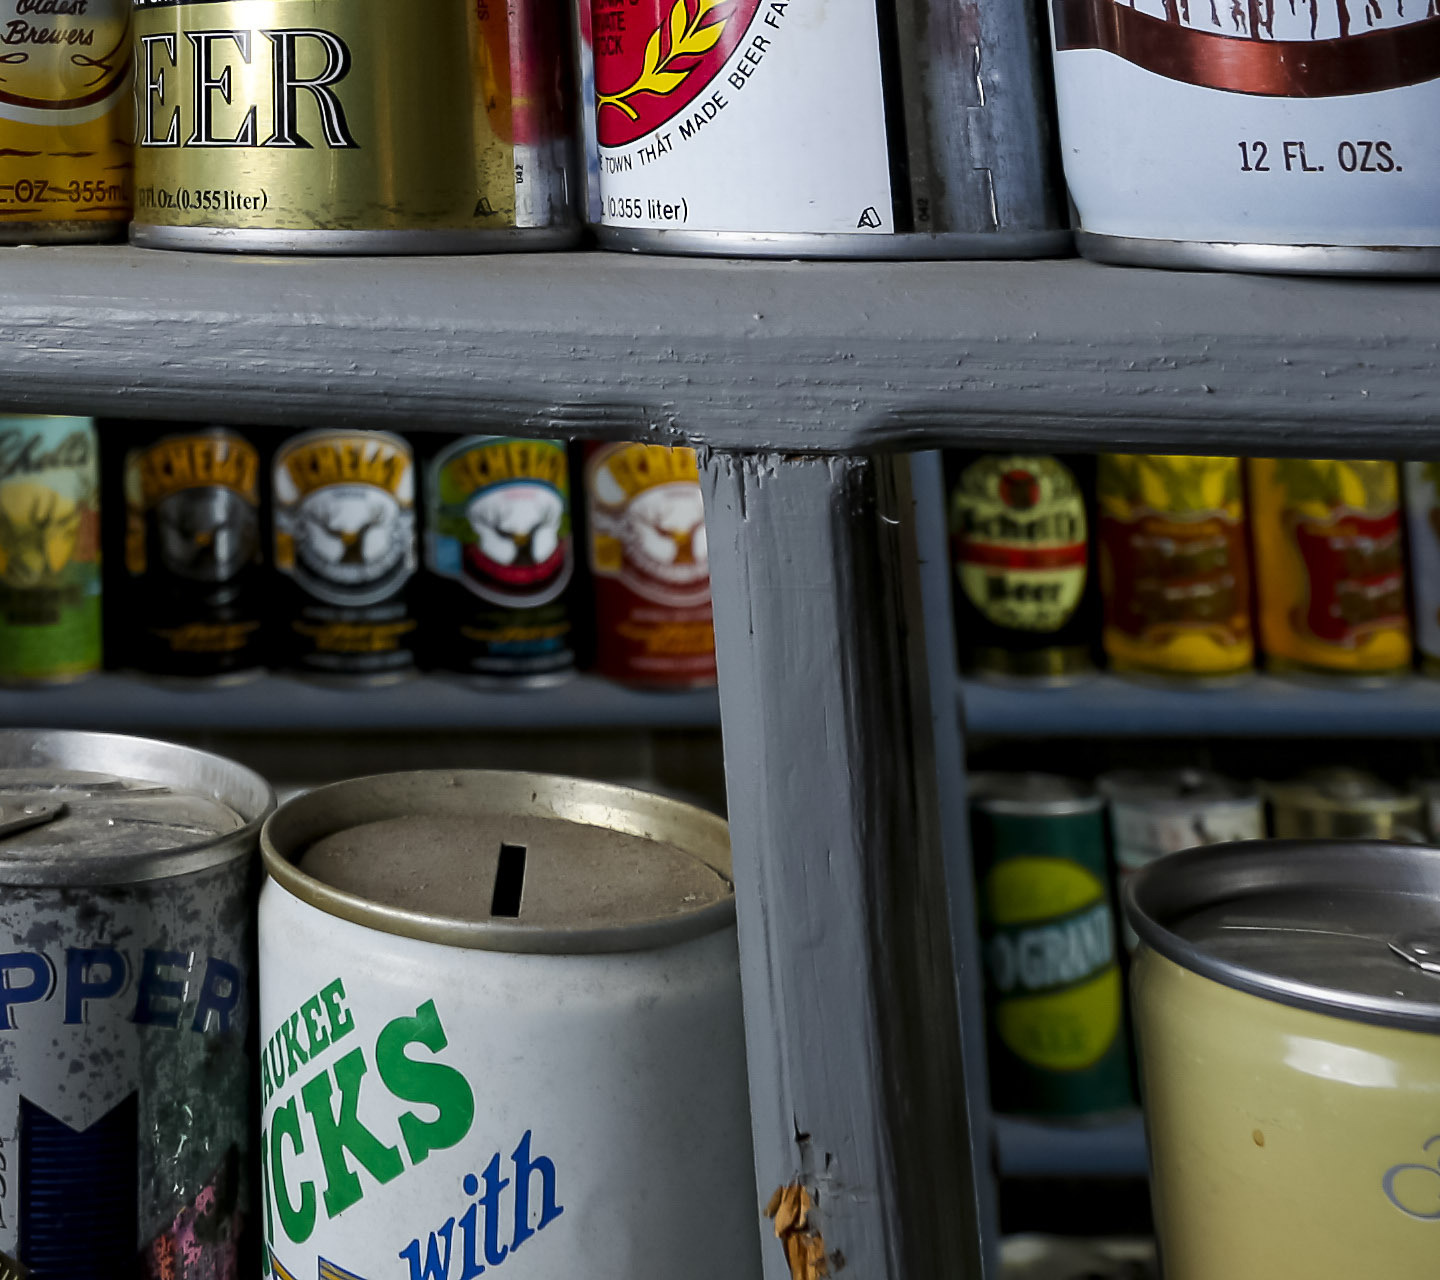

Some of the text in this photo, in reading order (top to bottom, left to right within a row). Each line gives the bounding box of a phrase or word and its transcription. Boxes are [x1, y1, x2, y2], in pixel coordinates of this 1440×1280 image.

[0, 19, 94, 47] Brewers
[133, 27, 361, 152] EER
[605, 153, 633, 174] TOWN
[637, 133, 674, 166] THAT
[678, 90, 729, 141] MADE
[727, 34, 771, 90] BEER
[1237, 140, 1403, 174] 12 FL. OZS.
[608, 197, 688, 223] (0.355 liter)
[260, 975, 357, 1118] AUKEE
[396, 1128, 564, 1280] with
